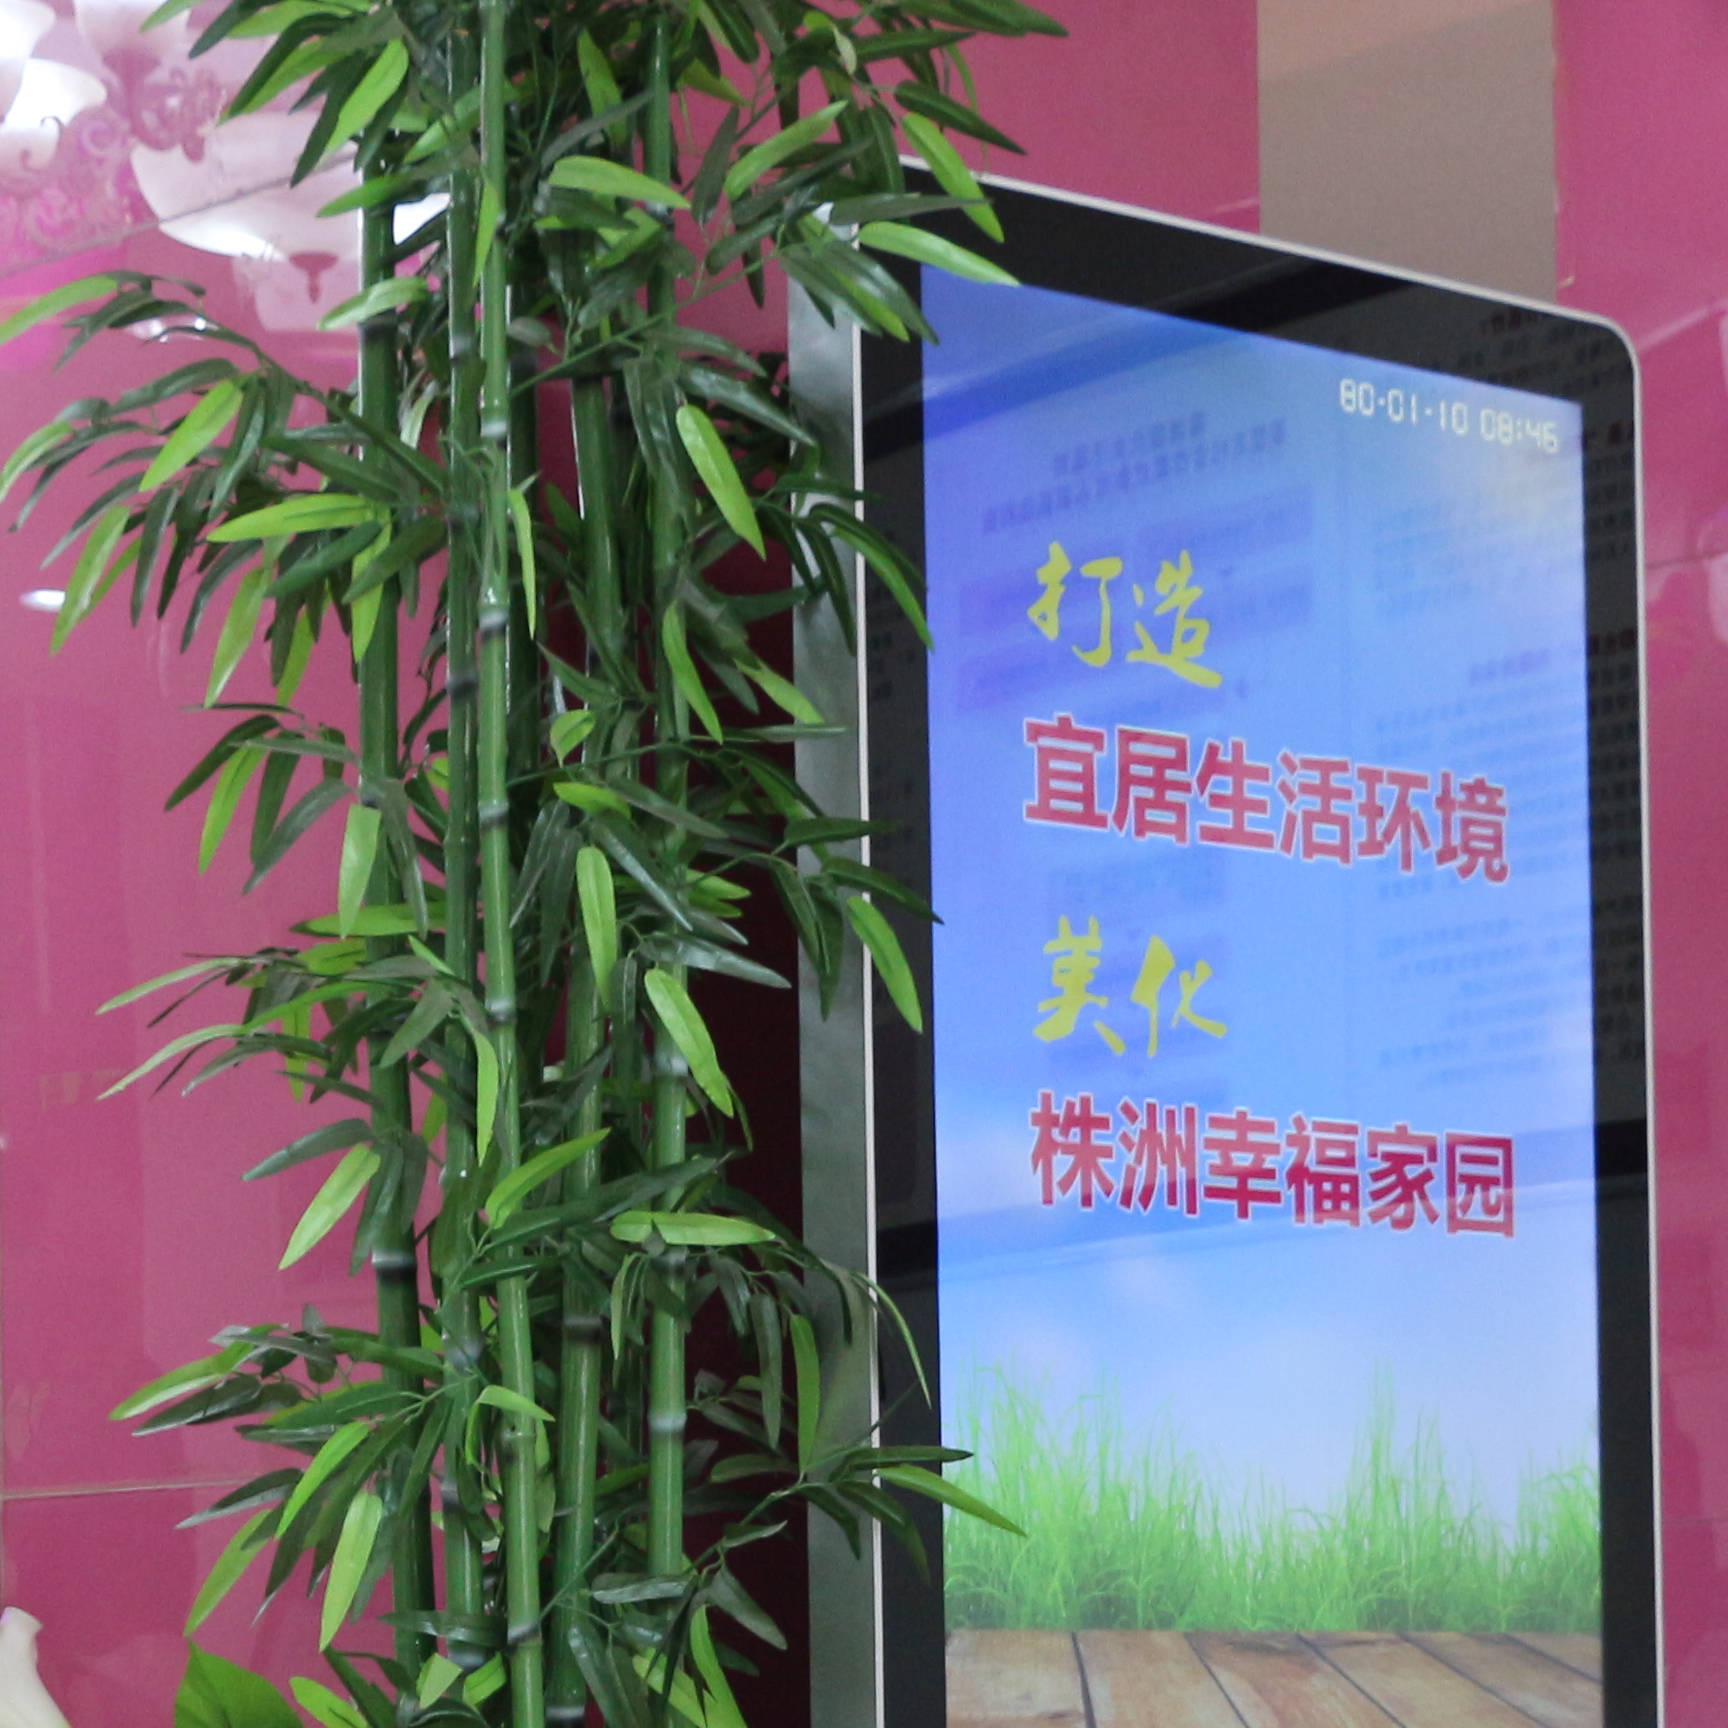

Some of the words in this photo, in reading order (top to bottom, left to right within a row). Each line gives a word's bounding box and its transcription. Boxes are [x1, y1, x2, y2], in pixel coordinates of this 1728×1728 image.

[1480, 407, 1559, 453] 08:46
[1028, 542, 1222, 687] 打造
[1023, 713, 1509, 884] 宜居生活环境
[1034, 917, 1226, 1056] 美化
[1030, 1089, 1515, 1239] 株洲幸福家园
